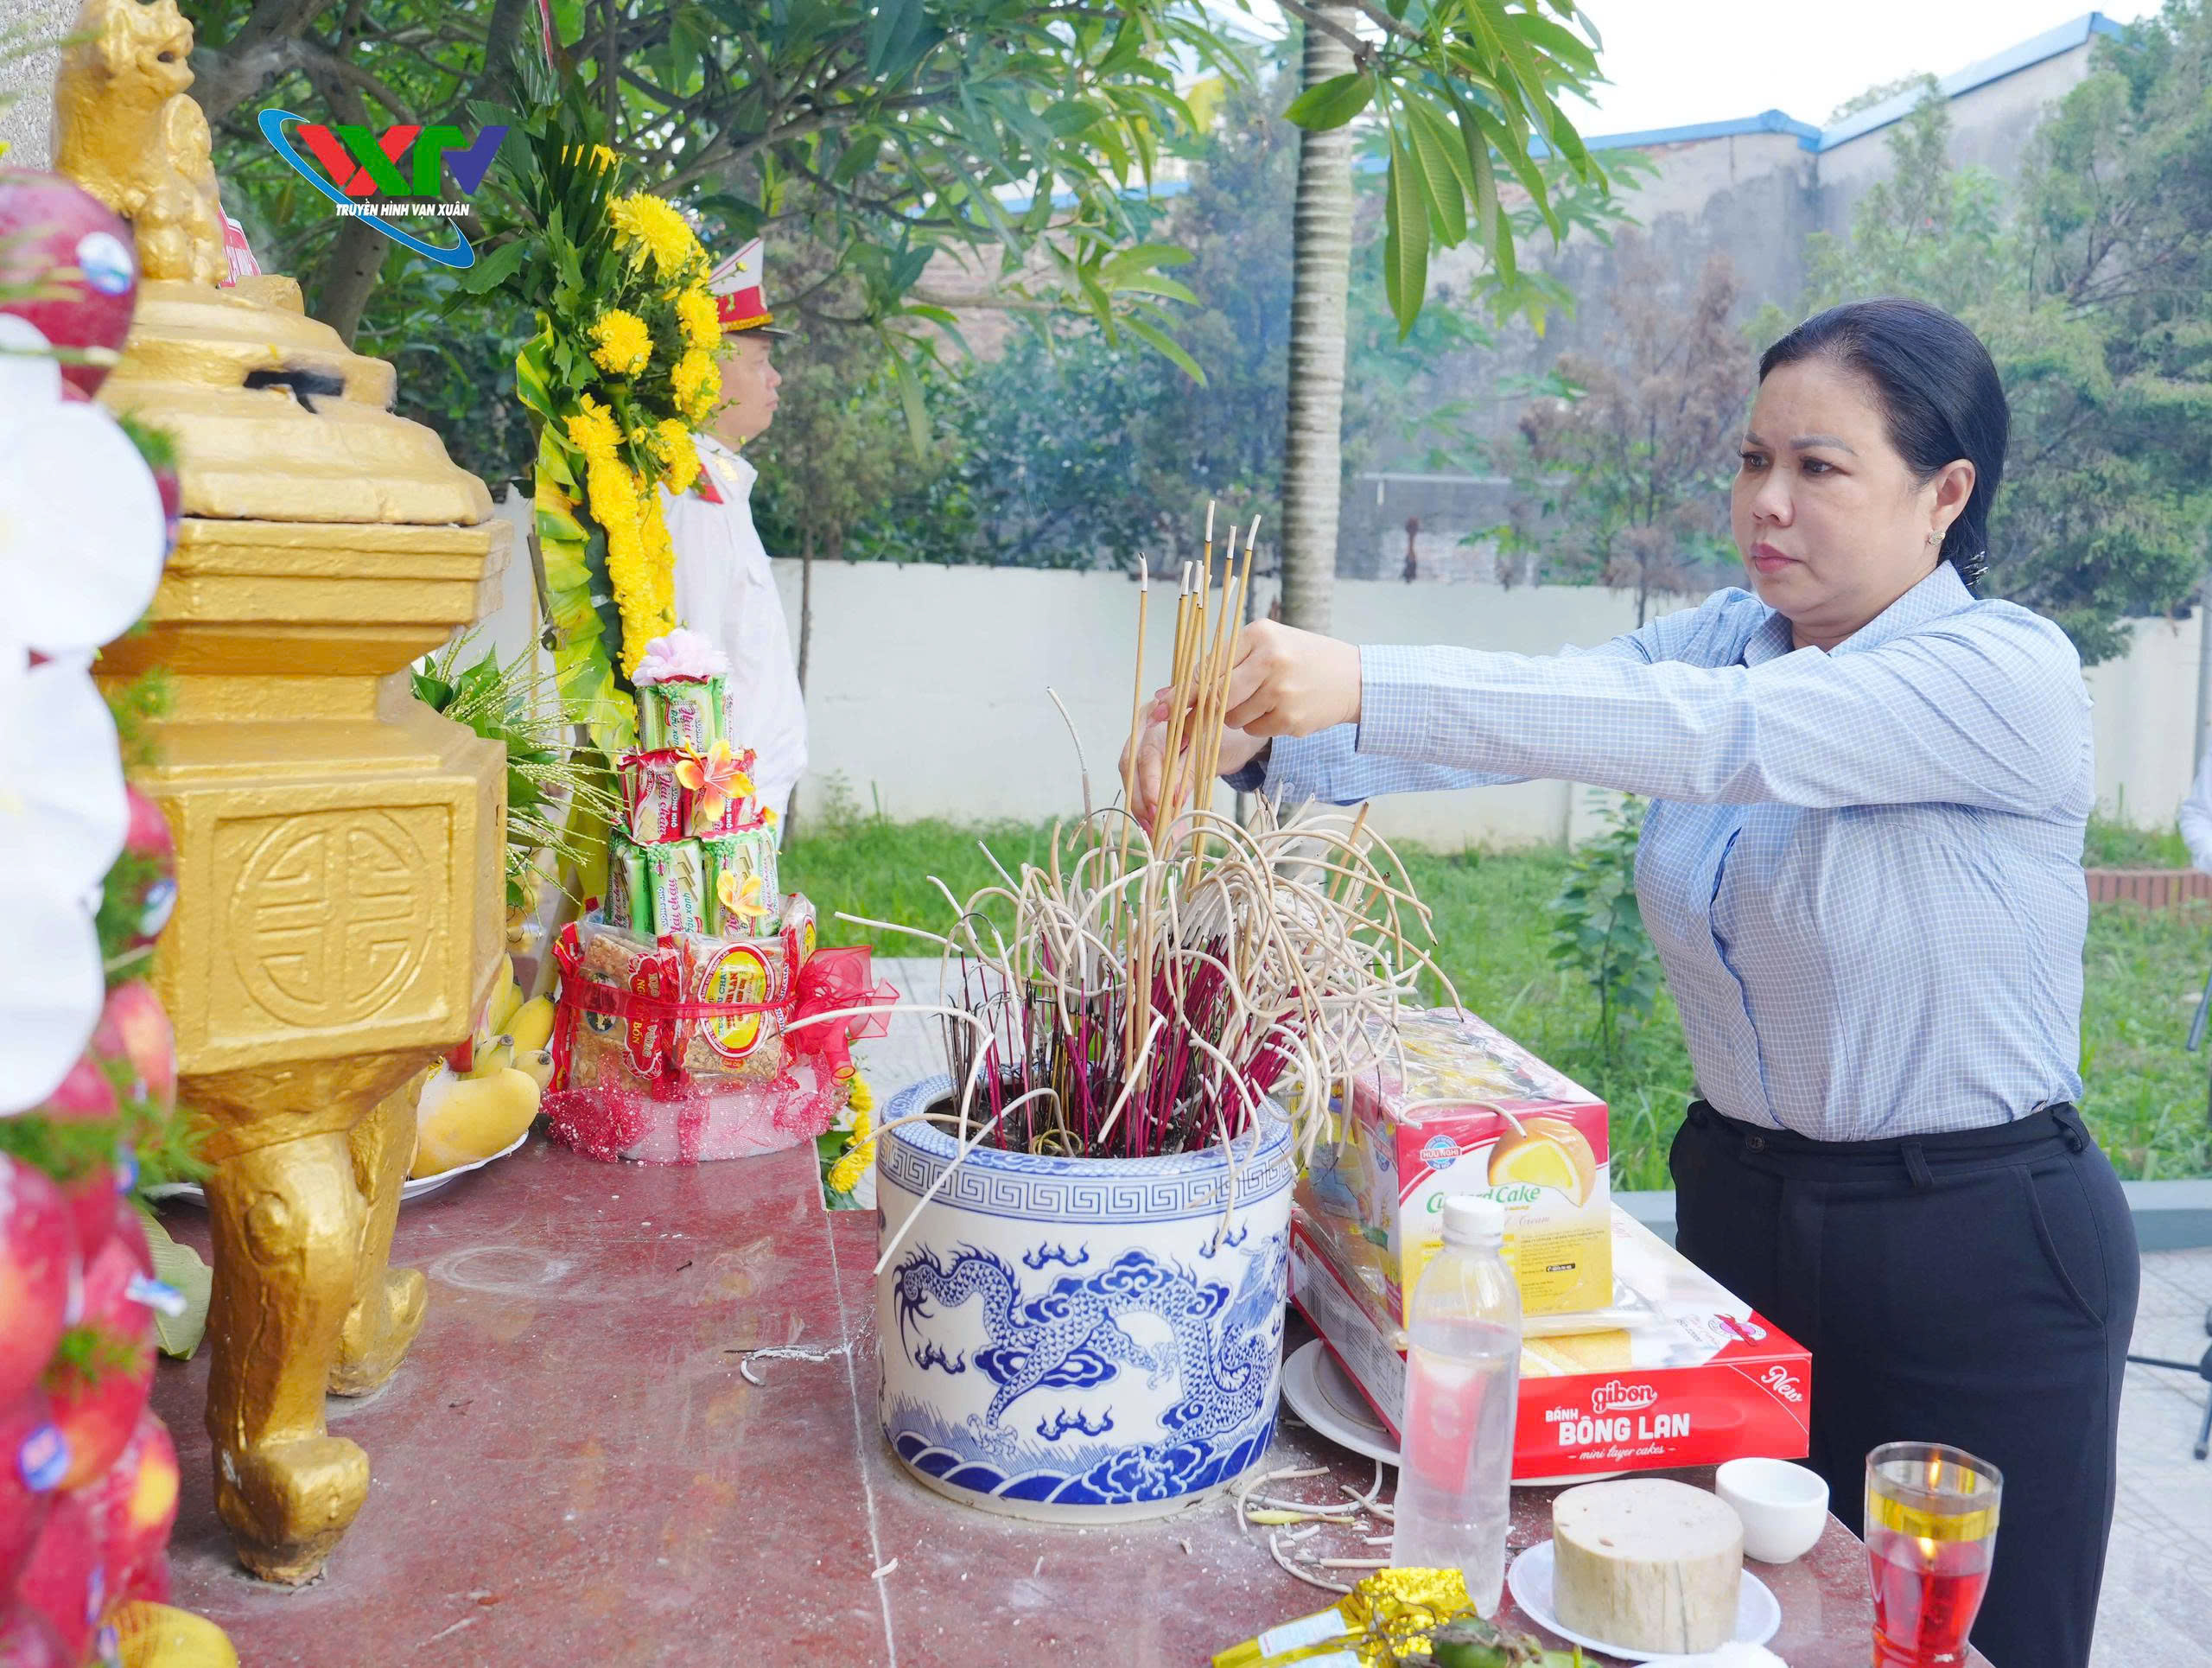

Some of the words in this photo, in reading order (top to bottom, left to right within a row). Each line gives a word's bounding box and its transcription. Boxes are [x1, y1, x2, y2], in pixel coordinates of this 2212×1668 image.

[1496, 1185, 1541, 1203] Cake
[1592, 1380, 1657, 1414] gibon
[1760, 1366, 1803, 1402] New
[1545, 1405, 1579, 1423] BÁNH
[1559, 1416, 1631, 1446] BÔNG
[1638, 1413, 1690, 1441] LAN
[1580, 1448, 1605, 1461] mini
[1607, 1444, 1636, 1462] layer
[1636, 1442, 1665, 1455] cakes
